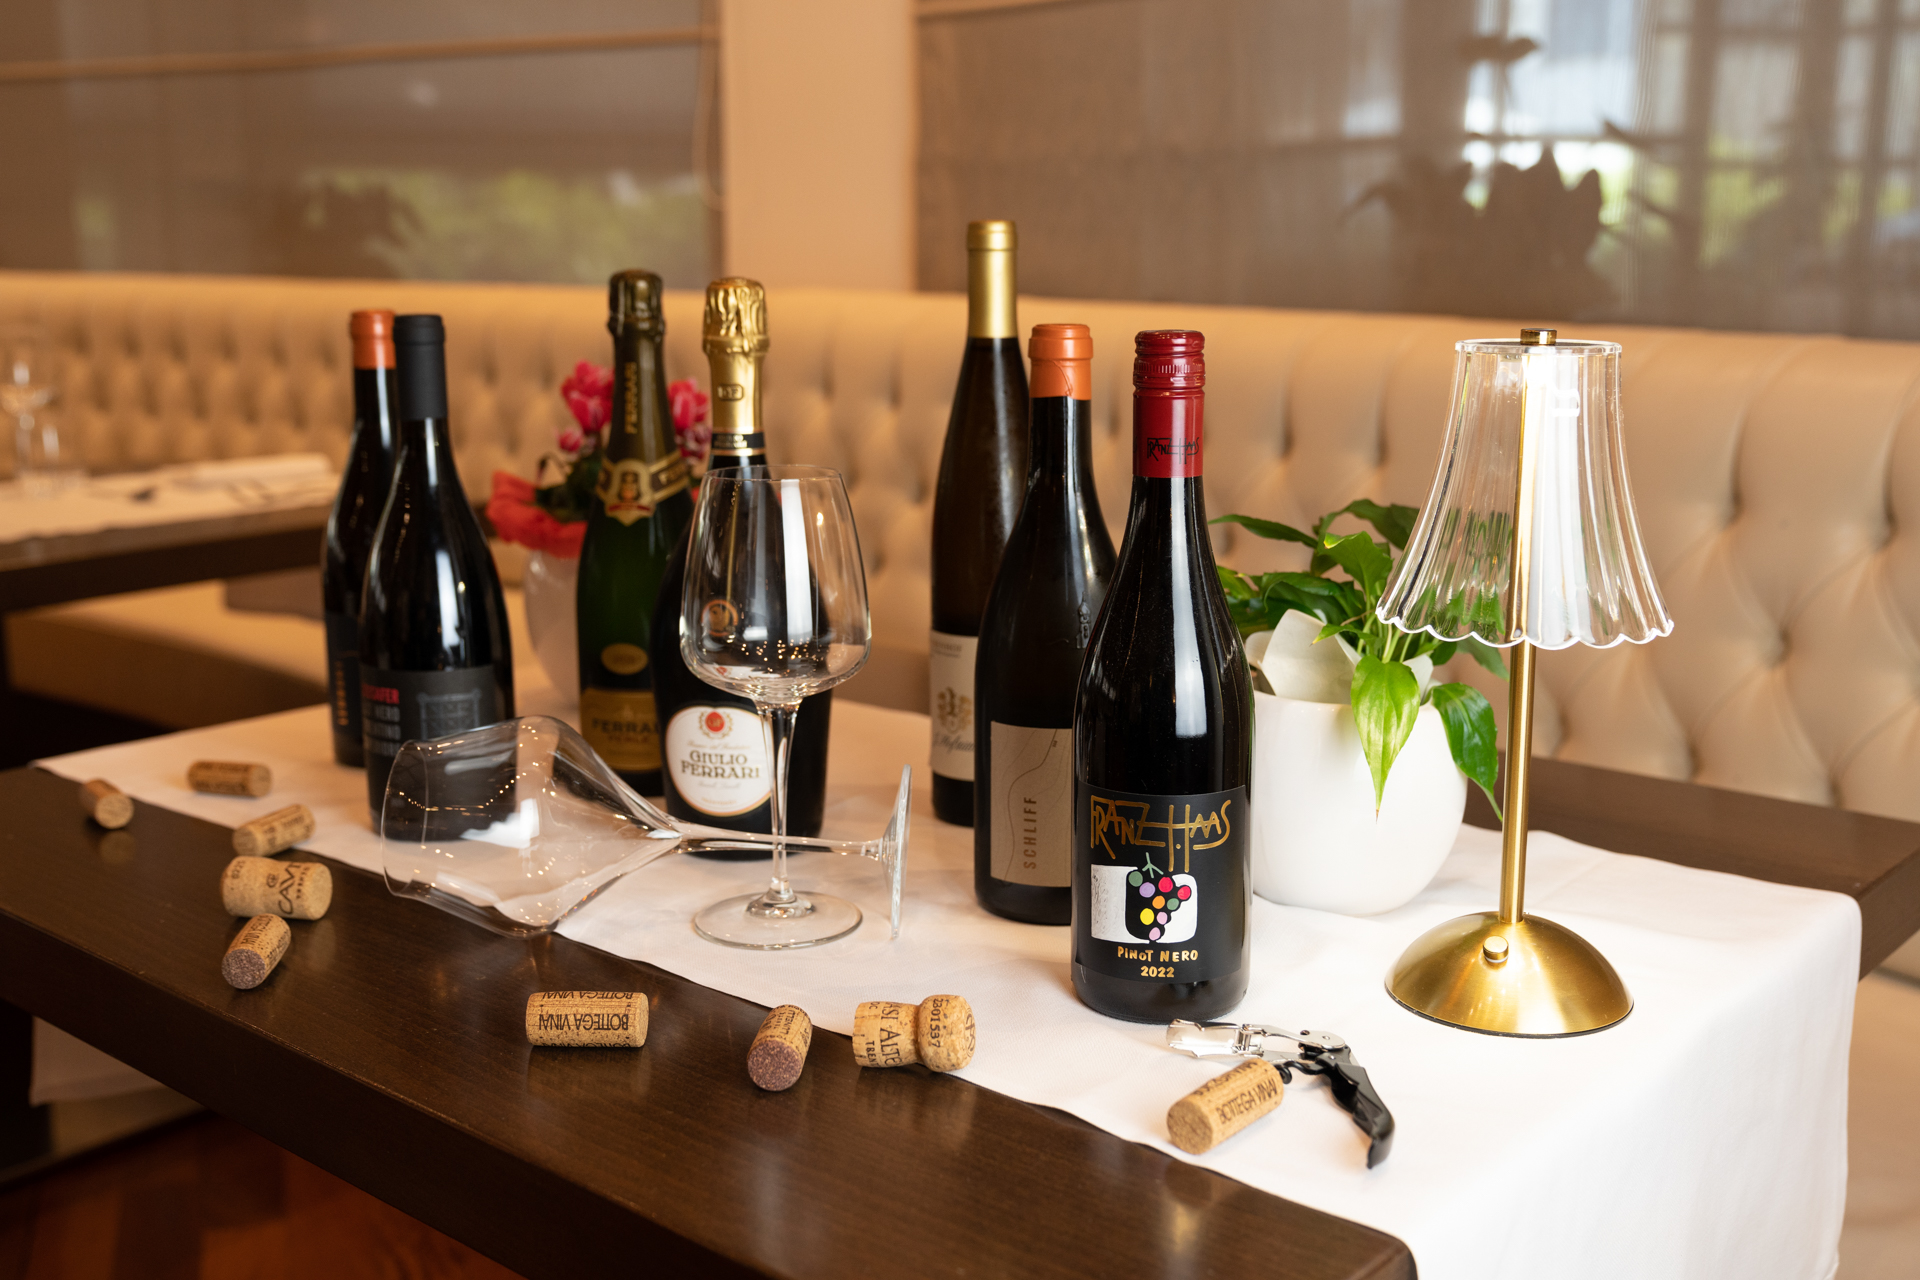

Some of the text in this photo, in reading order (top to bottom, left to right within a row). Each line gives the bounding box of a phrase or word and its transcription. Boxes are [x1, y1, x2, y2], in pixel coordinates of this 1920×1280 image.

[689, 749, 748, 765] GIULIO
[681, 760, 760, 779] FERRARI
[1023, 797, 1038, 870] SCHLIFF
[1091, 795, 1232, 873] FRANZ HAAS
[1117, 945, 1199, 963] PINOT NERO
[1140, 966, 1175, 978] 2022
[539, 1013, 629, 1031] BOTTEGA VINAI
[1215, 1089, 1257, 1125] BOTTEGA
[1252, 1076, 1278, 1103] VINAI
